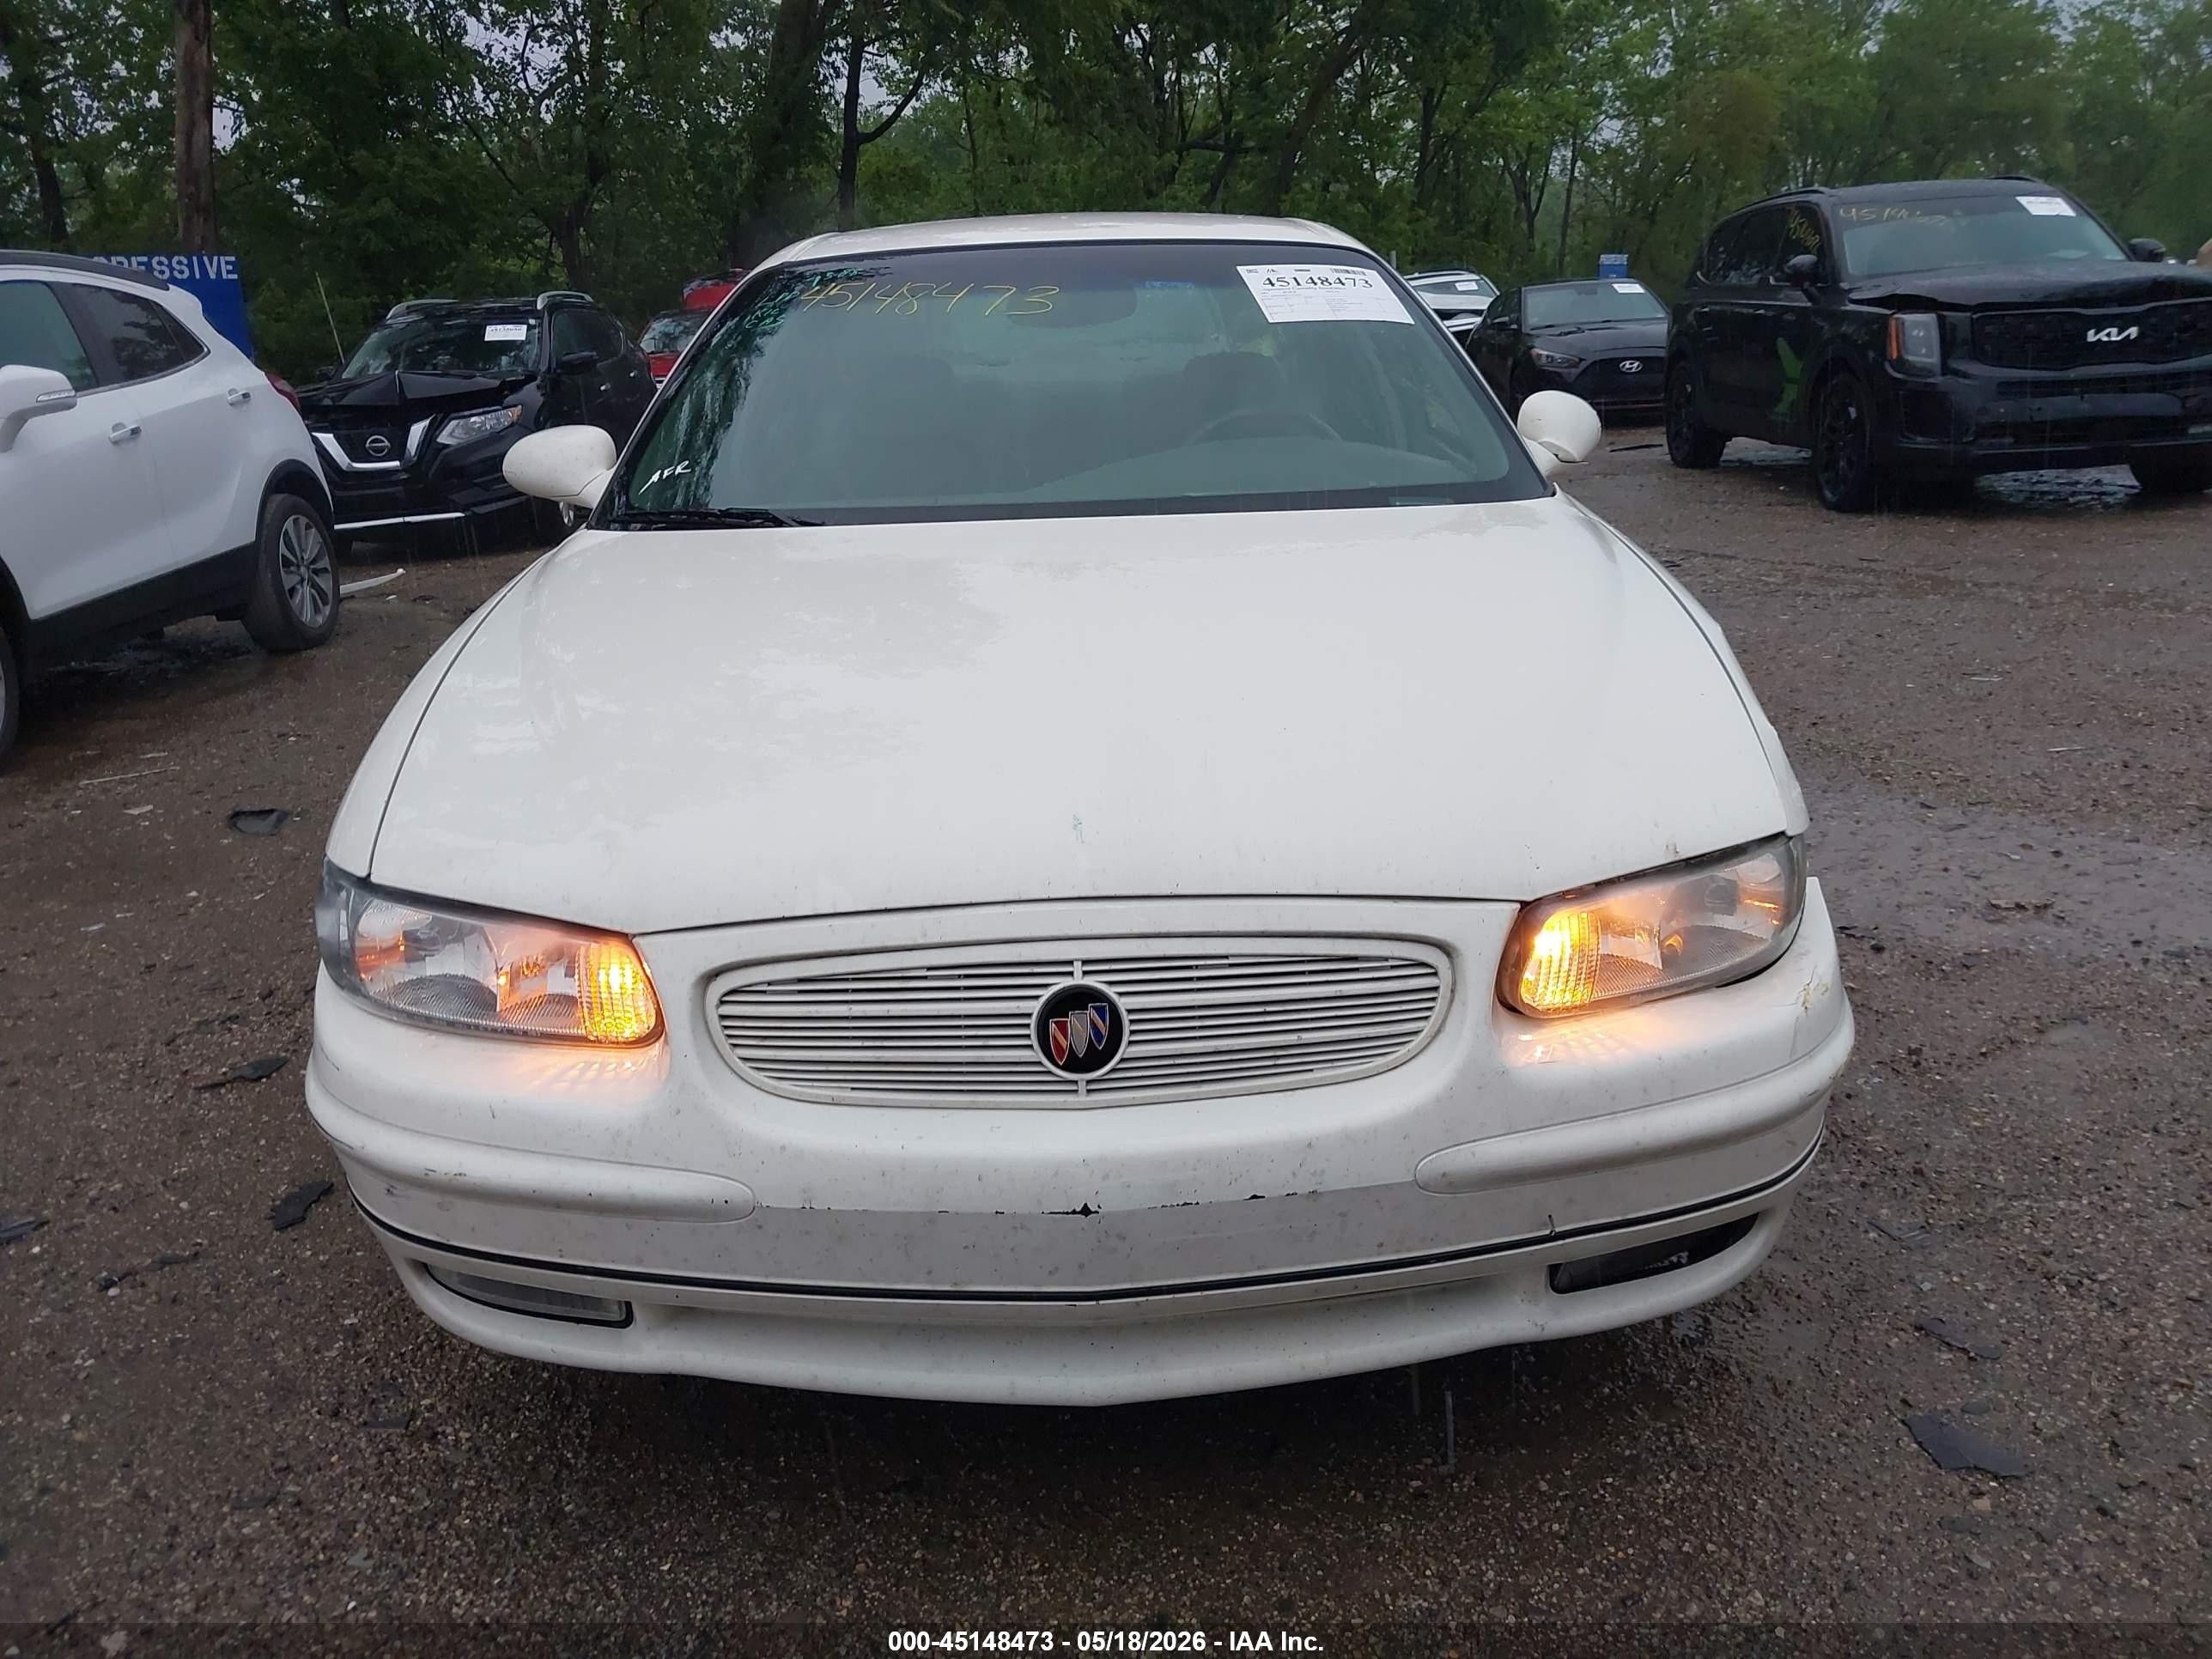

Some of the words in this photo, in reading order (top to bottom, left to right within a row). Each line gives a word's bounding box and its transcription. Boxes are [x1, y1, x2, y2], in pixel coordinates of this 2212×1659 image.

[1262, 276, 1373, 289] 45148473
[801, 282, 1060, 316] 45148473
[2087, 326, 2139, 342] KIA
